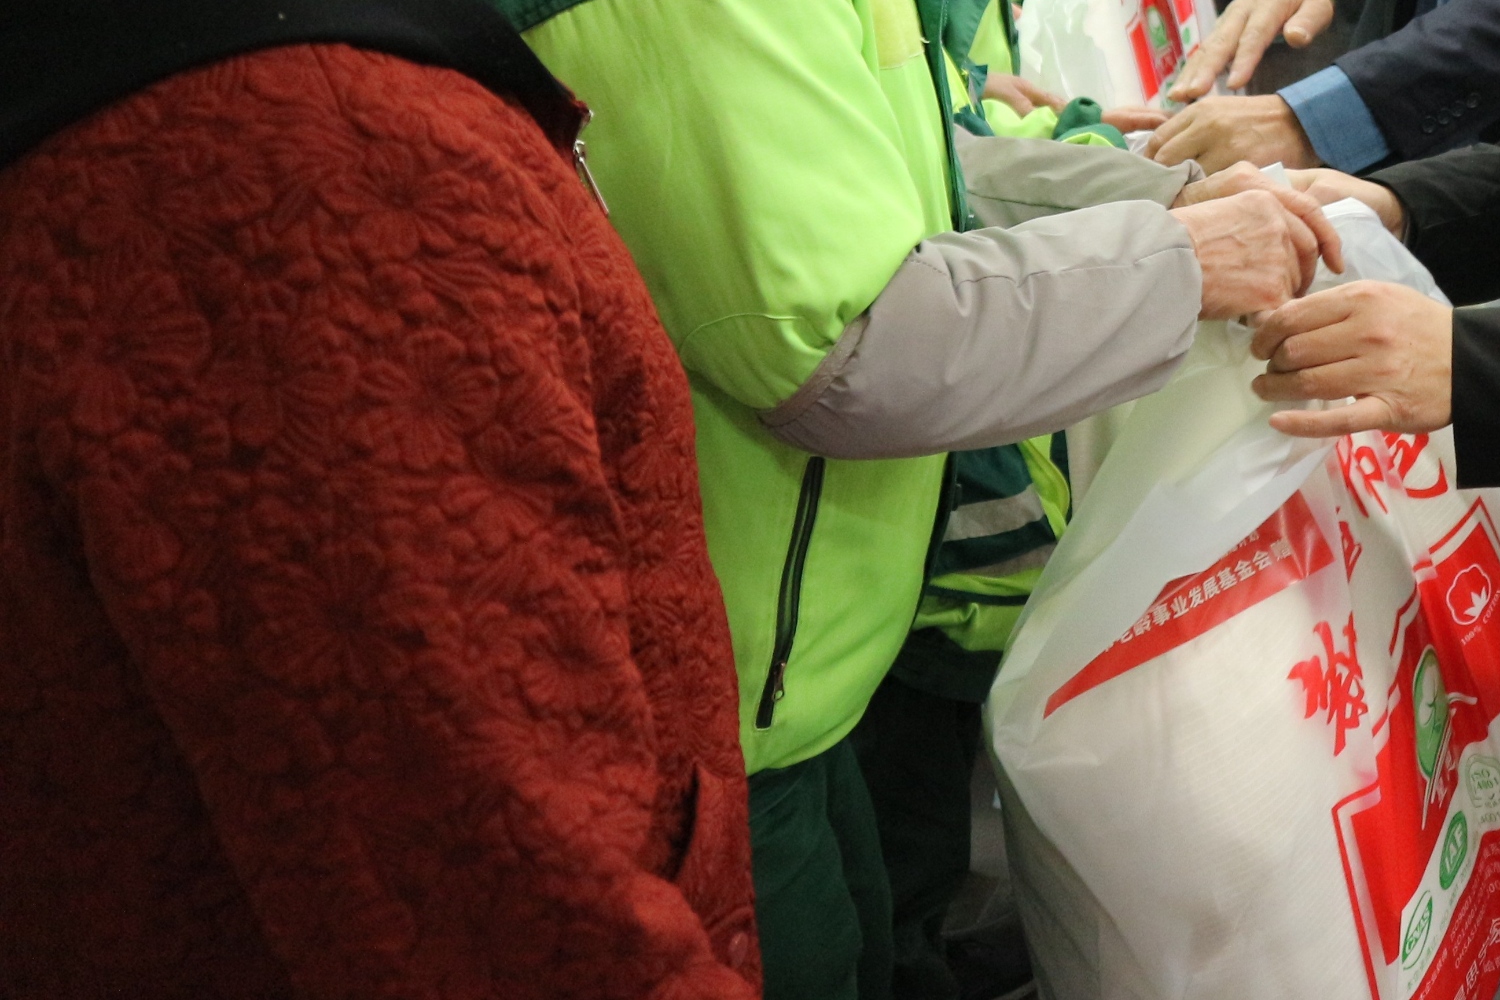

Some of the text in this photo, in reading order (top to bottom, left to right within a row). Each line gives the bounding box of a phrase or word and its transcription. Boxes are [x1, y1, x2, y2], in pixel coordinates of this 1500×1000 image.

[1105, 549, 1273, 653] 龄事业发展基金会
